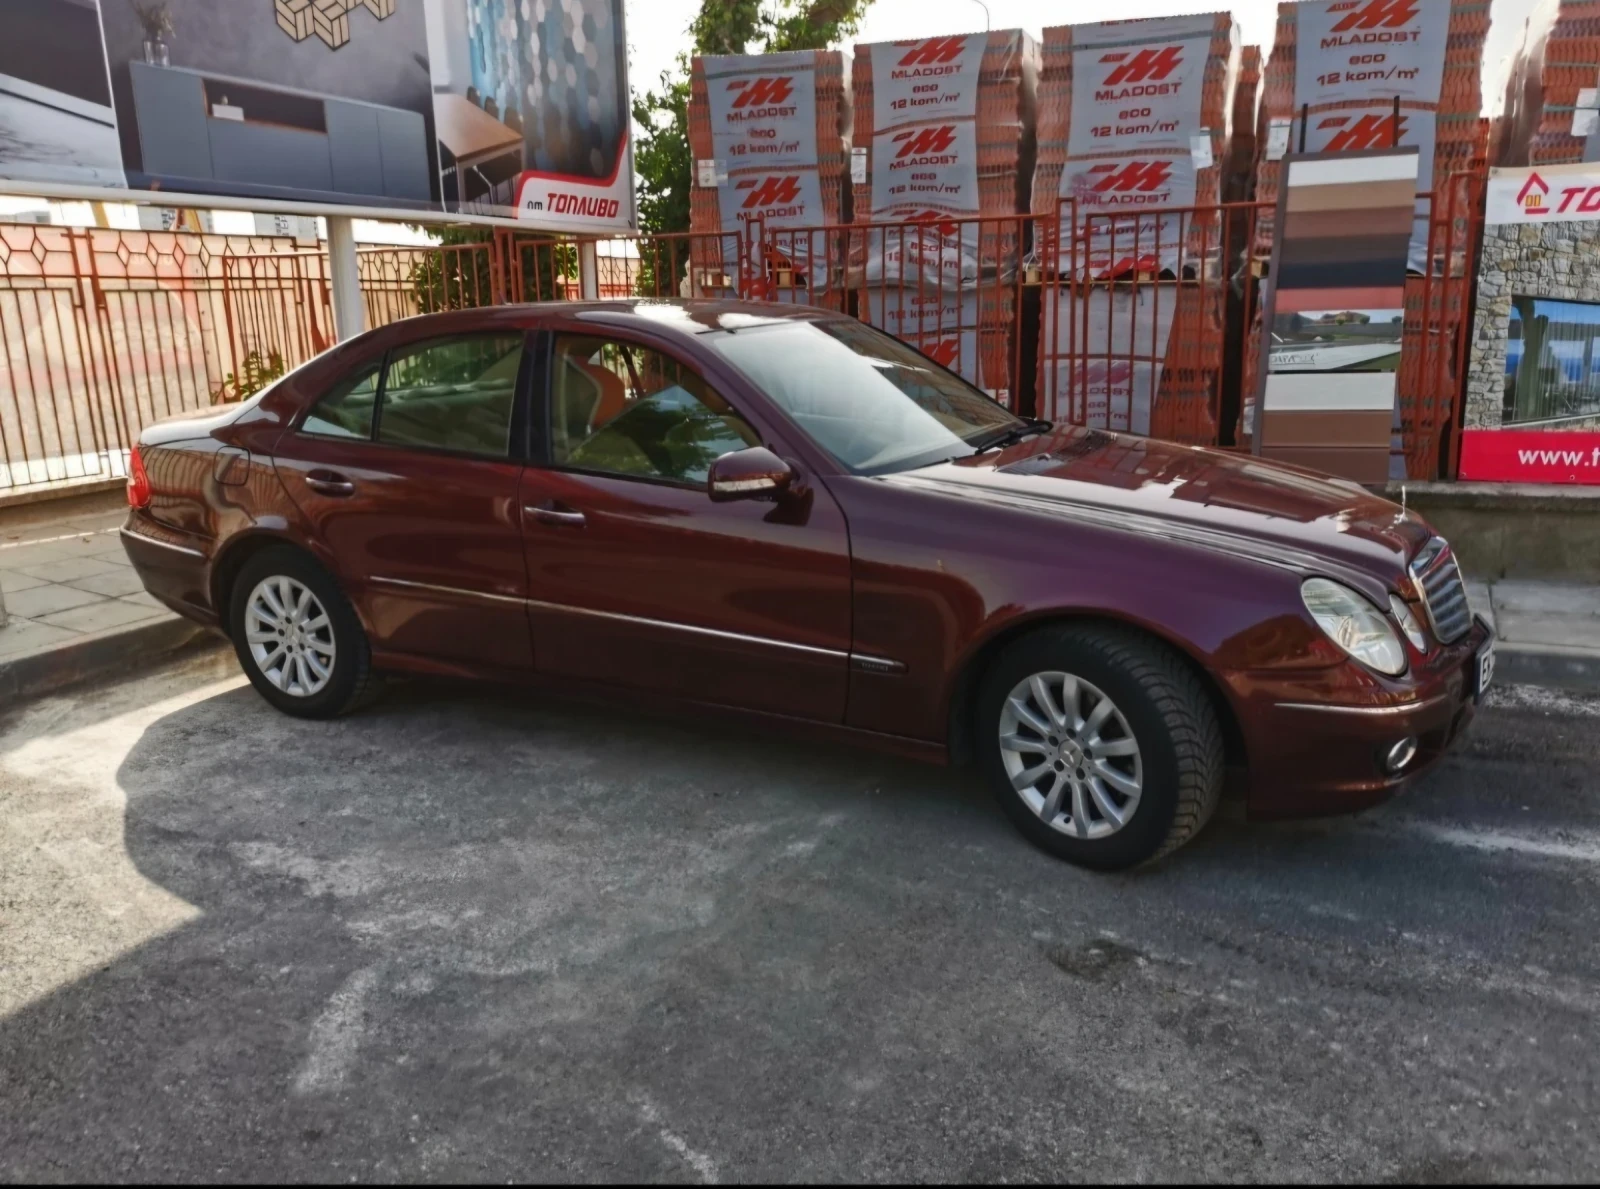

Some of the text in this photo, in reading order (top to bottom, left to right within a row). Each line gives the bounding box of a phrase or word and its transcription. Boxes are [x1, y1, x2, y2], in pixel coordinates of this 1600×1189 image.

[1320, 31, 1421, 49] MLADOST
[891, 65, 962, 80] MLADOST
[1317, 72, 1341, 86] 12
[1095, 82, 1182, 101] MLADOST
[890, 98, 907, 110] 12
[726, 106, 797, 123] MLADOST
[1090, 126, 1112, 137] 12
[729, 144, 746, 156] 12
[889, 155, 959, 171] MLADOST
